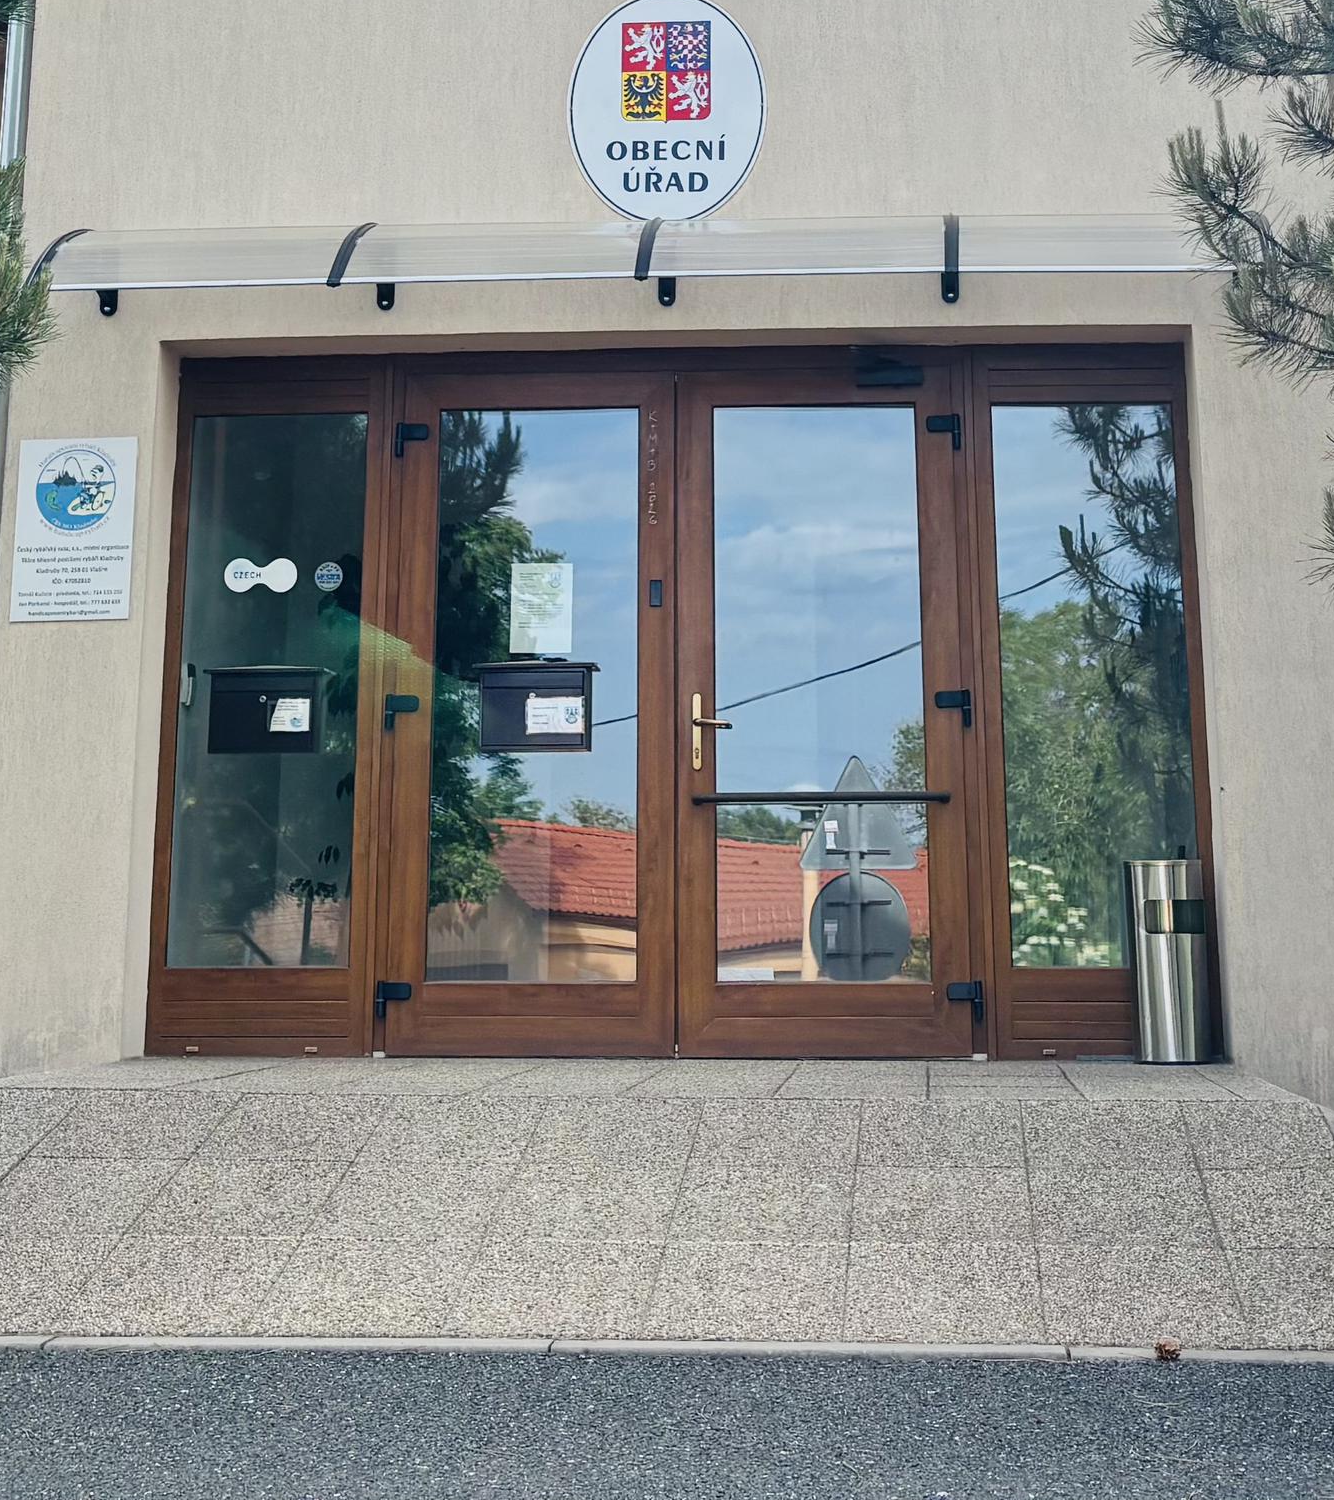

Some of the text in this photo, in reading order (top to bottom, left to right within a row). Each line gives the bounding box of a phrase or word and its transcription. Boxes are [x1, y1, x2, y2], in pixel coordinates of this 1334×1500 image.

[606, 134, 725, 161] OBECNÍ
[623, 166, 709, 193] ÚŘAD
[233, 571, 262, 579] CZECH
